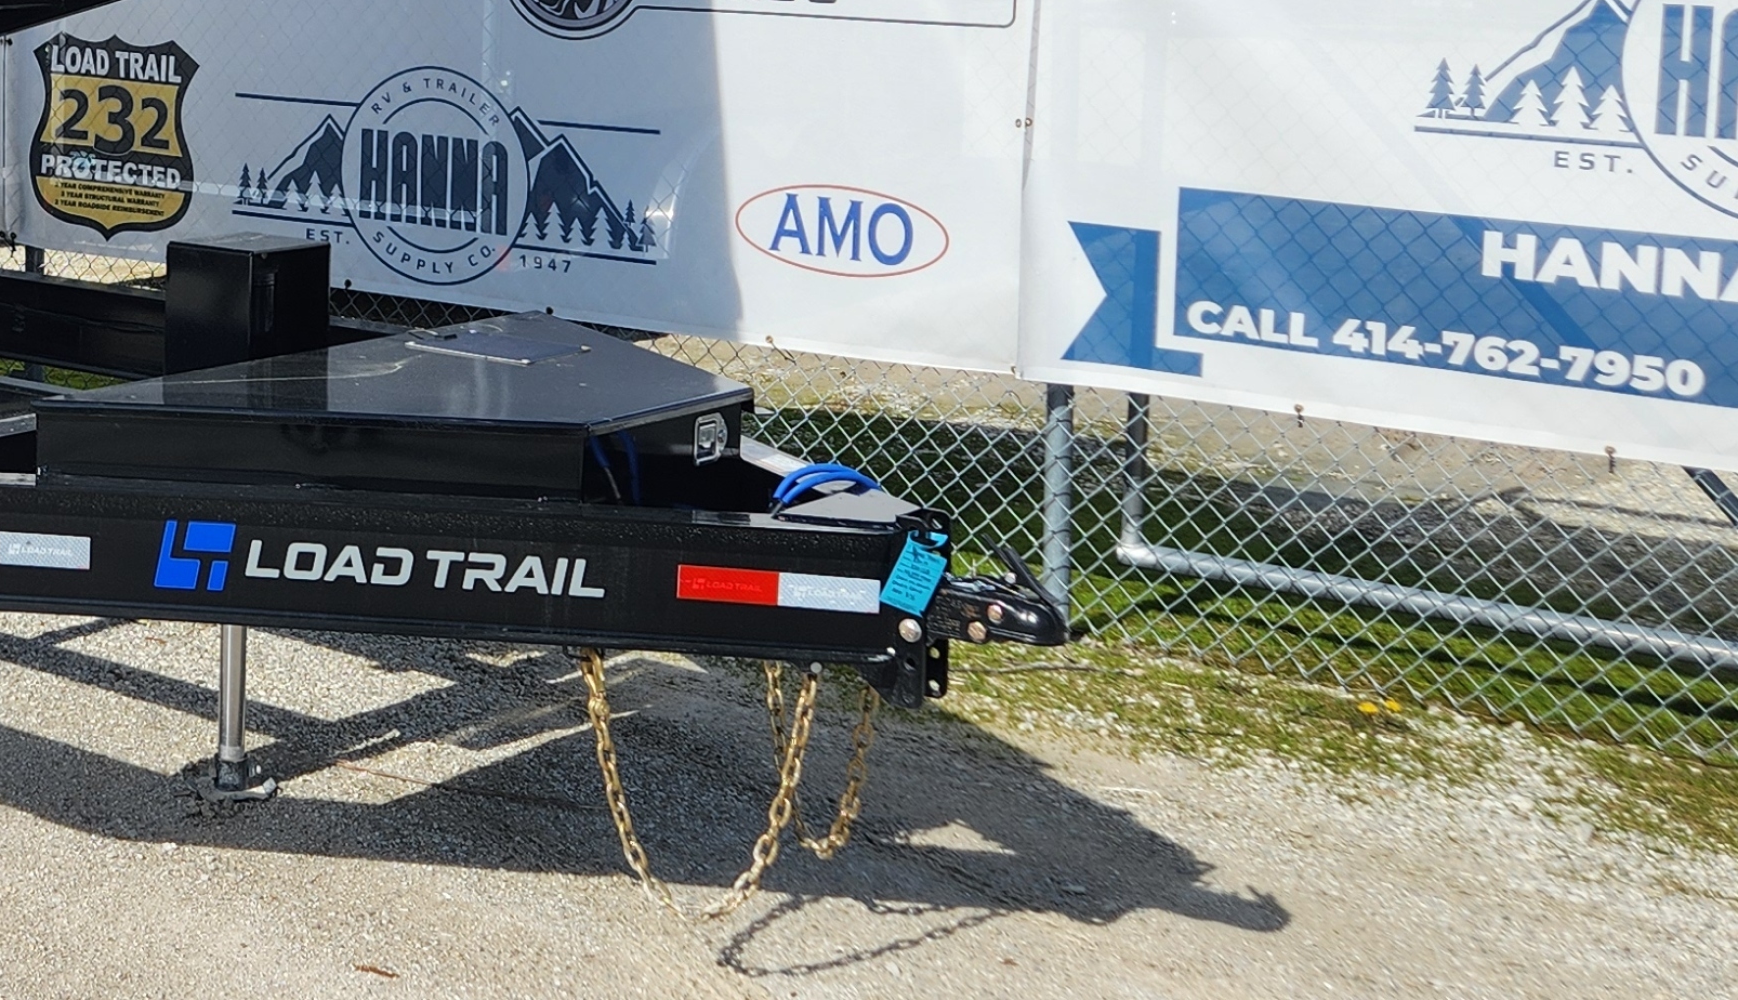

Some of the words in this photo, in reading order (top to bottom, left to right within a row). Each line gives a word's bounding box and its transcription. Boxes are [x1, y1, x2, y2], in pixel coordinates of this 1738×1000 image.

[50, 44, 110, 76] LOAD
[115, 50, 182, 84] TRAIL
[55, 85, 170, 155] 232
[370, 92, 393, 115] RV
[402, 81, 413, 93] &
[423, 77, 501, 127] TRAILER
[41, 153, 182, 190] PROTECTED
[358, 128, 509, 237] HANNA
[1553, 150, 1634, 174] EST.
[305, 228, 351, 245] EST.
[768, 193, 914, 266] AMO
[372, 231, 454, 274] SUPPLY
[467, 245, 497, 267] CO.
[519, 254, 573, 274] 1947
[1187, 300, 1320, 349] CALL
[1332, 316, 1708, 398] 414-762-7950
[245, 539, 415, 586] LOAD
[426, 550, 606, 599] TRAIL
[706, 580, 734, 590] LOAD
[735, 582, 763, 592] TRAIL
